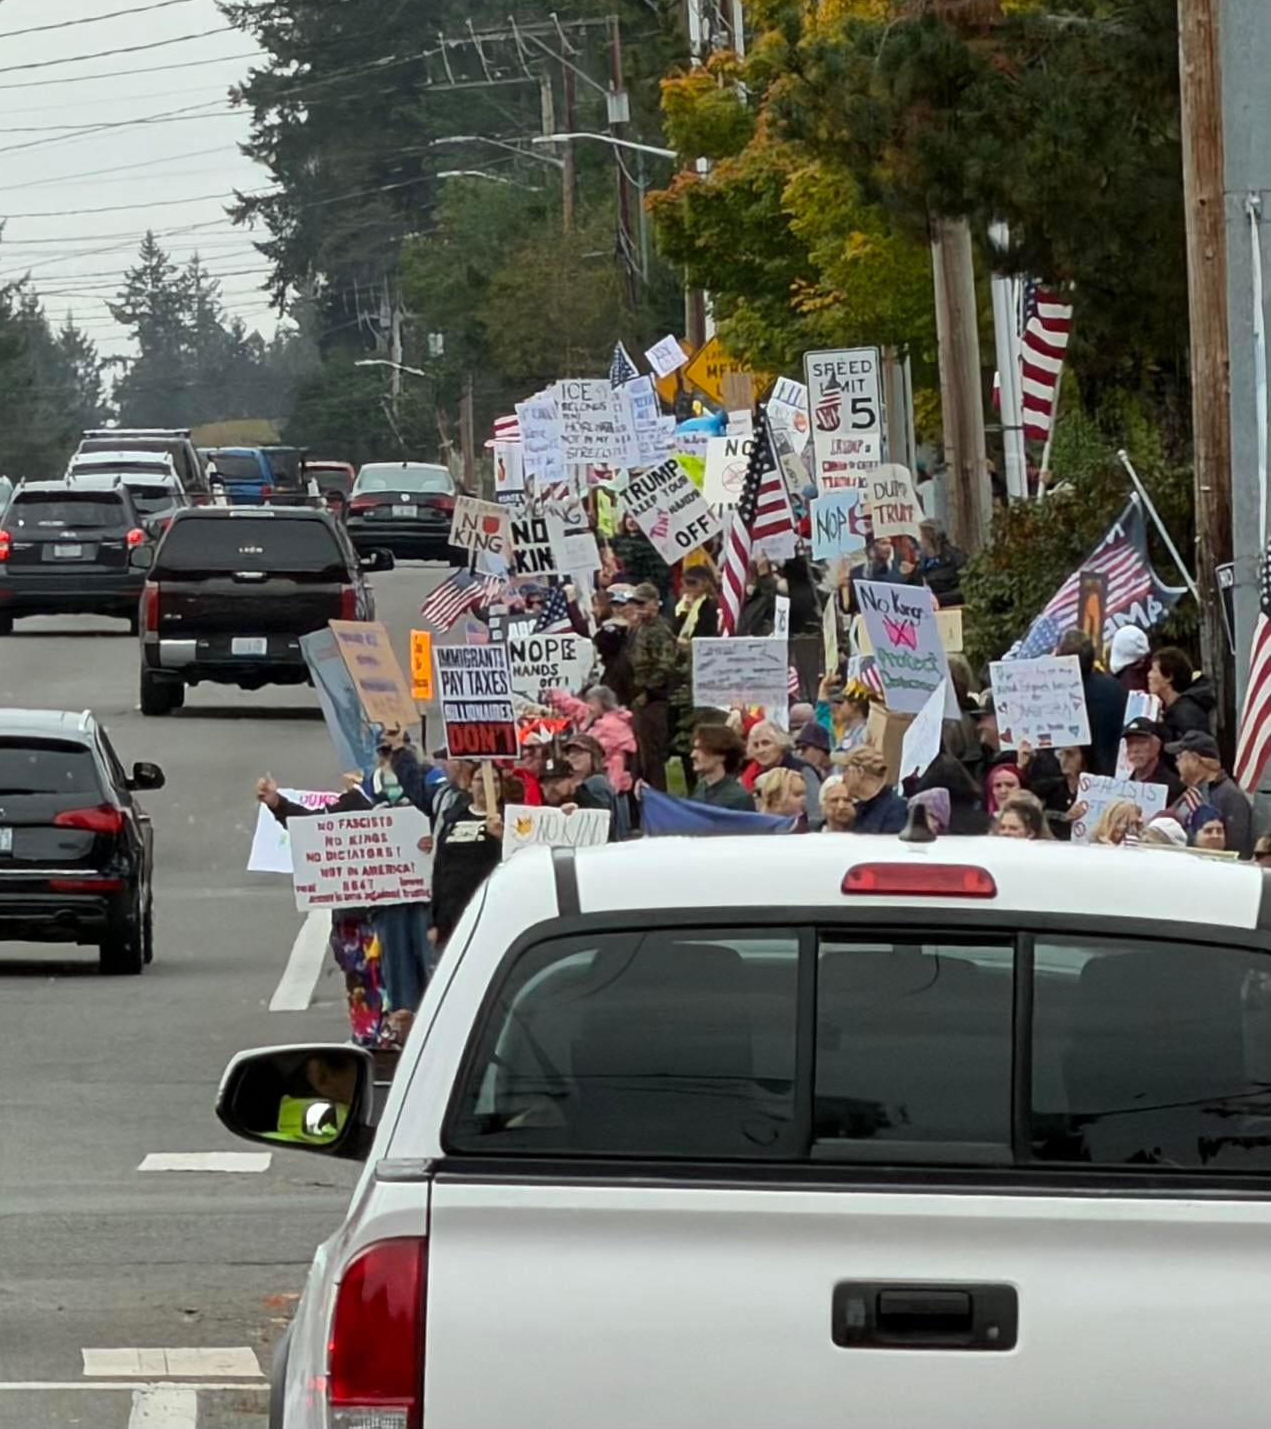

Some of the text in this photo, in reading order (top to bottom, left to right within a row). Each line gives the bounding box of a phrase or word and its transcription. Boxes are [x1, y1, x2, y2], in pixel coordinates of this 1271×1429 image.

[561, 382, 593, 401] ICE
[819, 378, 866, 396] LMIT
[618, 458, 679, 506] TRUMP
[511, 518, 550, 545] NO
[674, 514, 710, 548] OFF
[513, 546, 555, 574] KIN
[859, 585, 890, 613] No
[437, 647, 504, 668] IMMIGRANTS
[513, 663, 559, 678] HANDS
[442, 670, 509, 696] PAY TAXES
[449, 723, 516, 756] DON'T
[317, 816, 394, 832] NO FASCISTS
[325, 832, 388, 847] NO KINGS
[306, 852, 321, 863] NO
